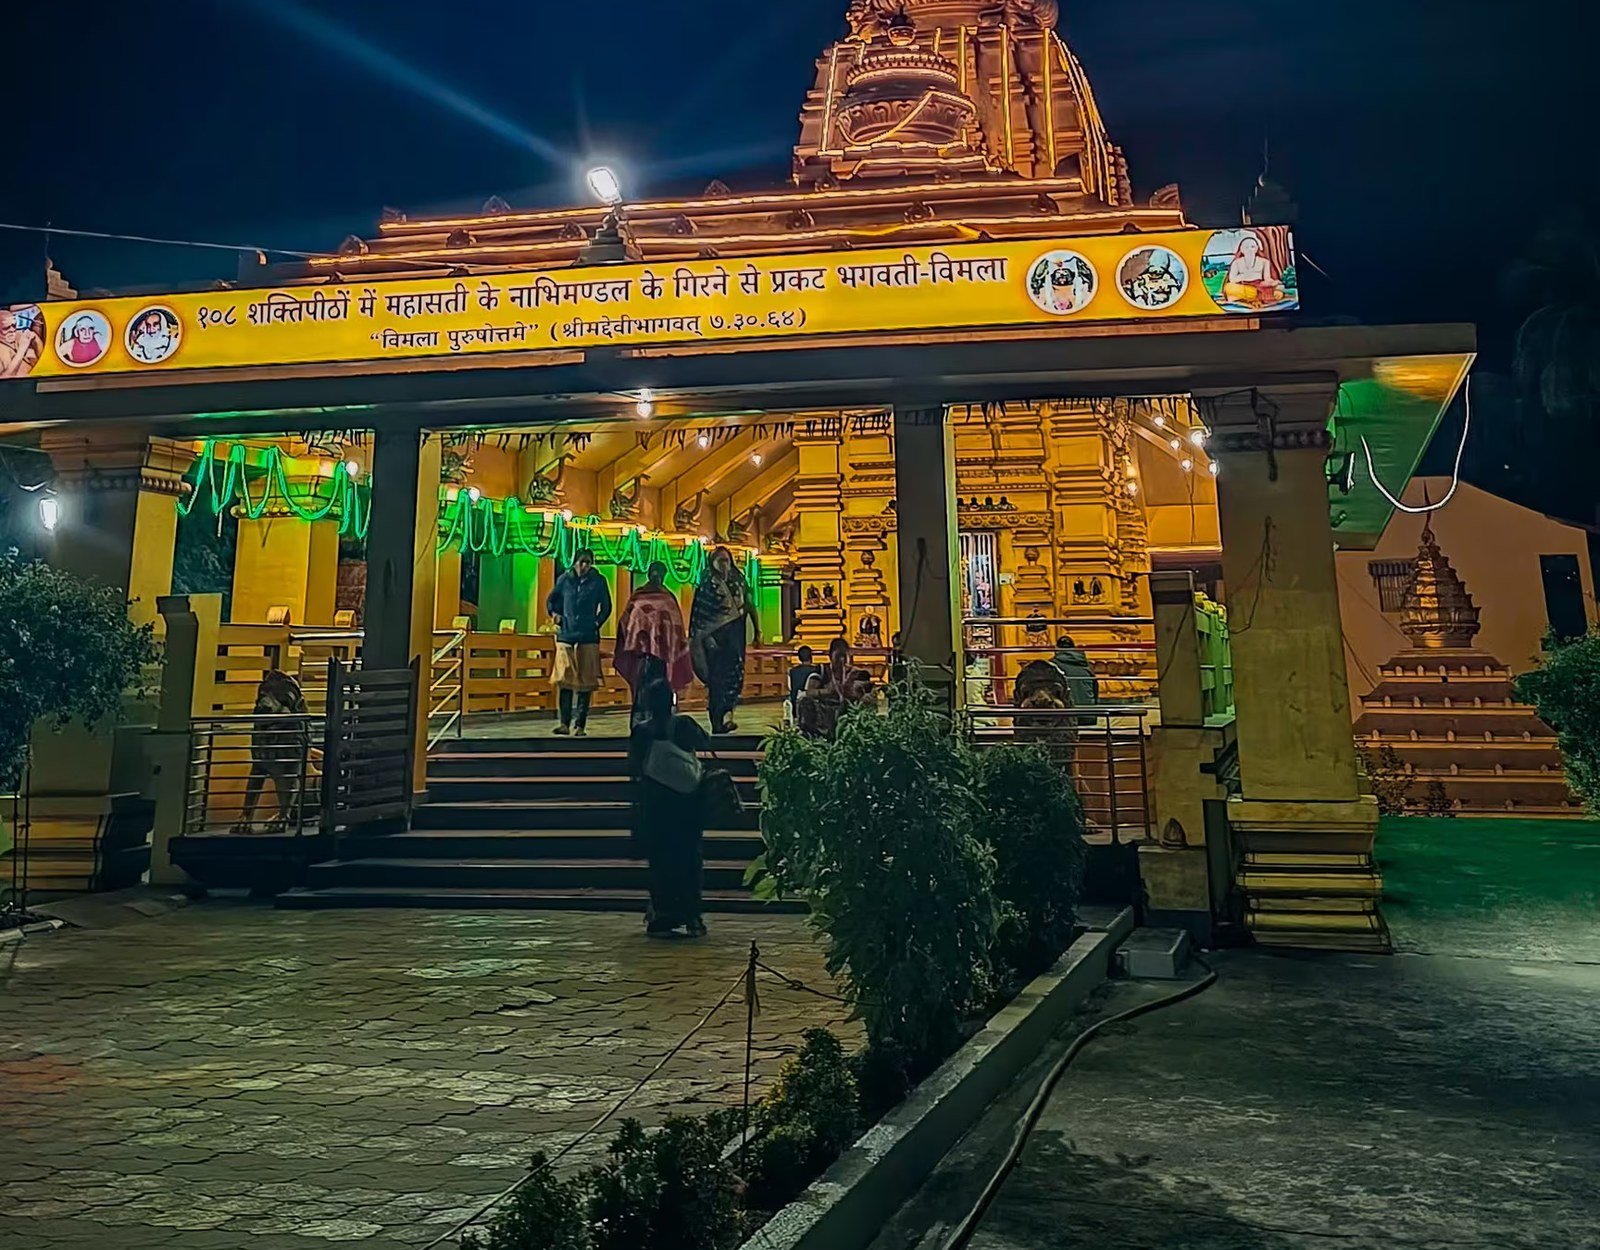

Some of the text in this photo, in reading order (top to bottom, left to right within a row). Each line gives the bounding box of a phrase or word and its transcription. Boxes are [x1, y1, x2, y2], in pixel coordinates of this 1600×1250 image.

[197, 252, 1008, 328] १०८ शक्तिपीठों में महासती के नाभिमण्डल के गिरने से प्रकट भगवती-विमला
[370, 328, 438, 349] “विमला
